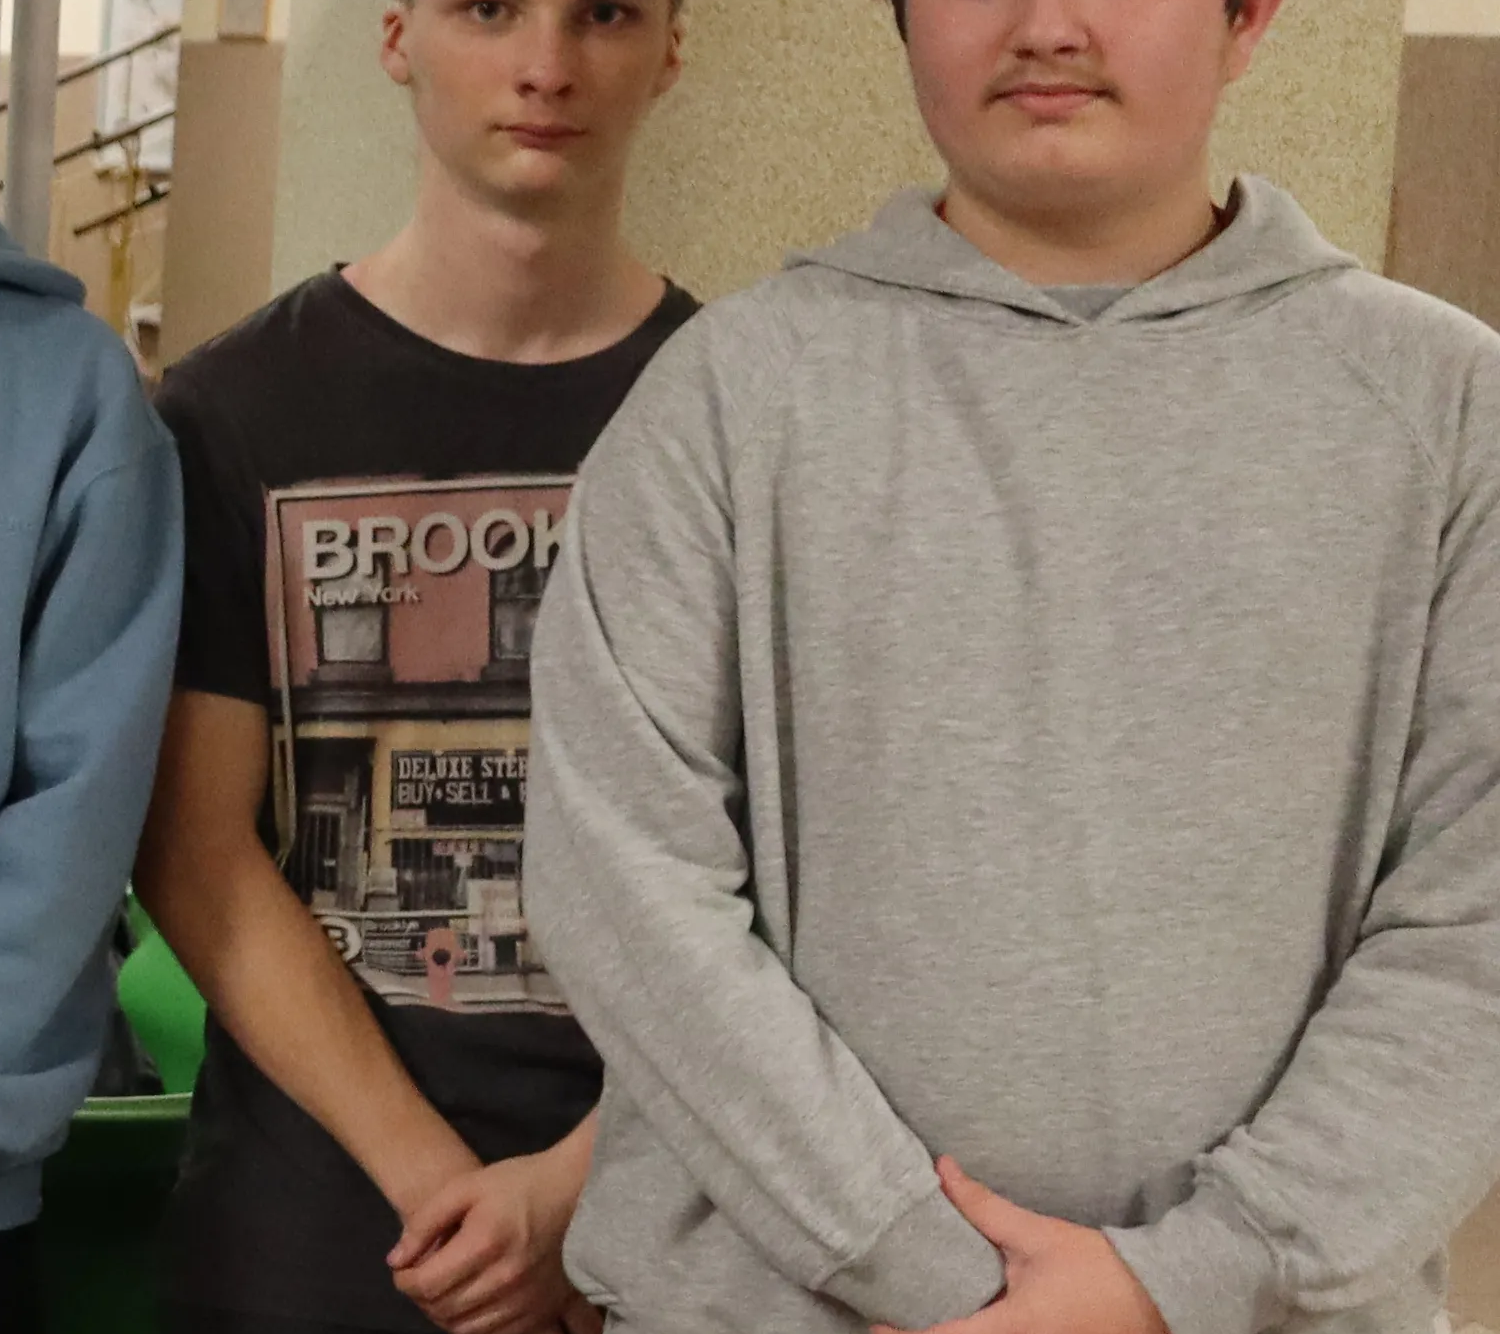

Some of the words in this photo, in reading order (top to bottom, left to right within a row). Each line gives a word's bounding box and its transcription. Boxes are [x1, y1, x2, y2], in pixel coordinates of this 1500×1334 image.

[301, 509, 566, 581] BROOK
[304, 585, 357, 608] New
[364, 582, 422, 604] York
[398, 755, 473, 780] DELUXE
